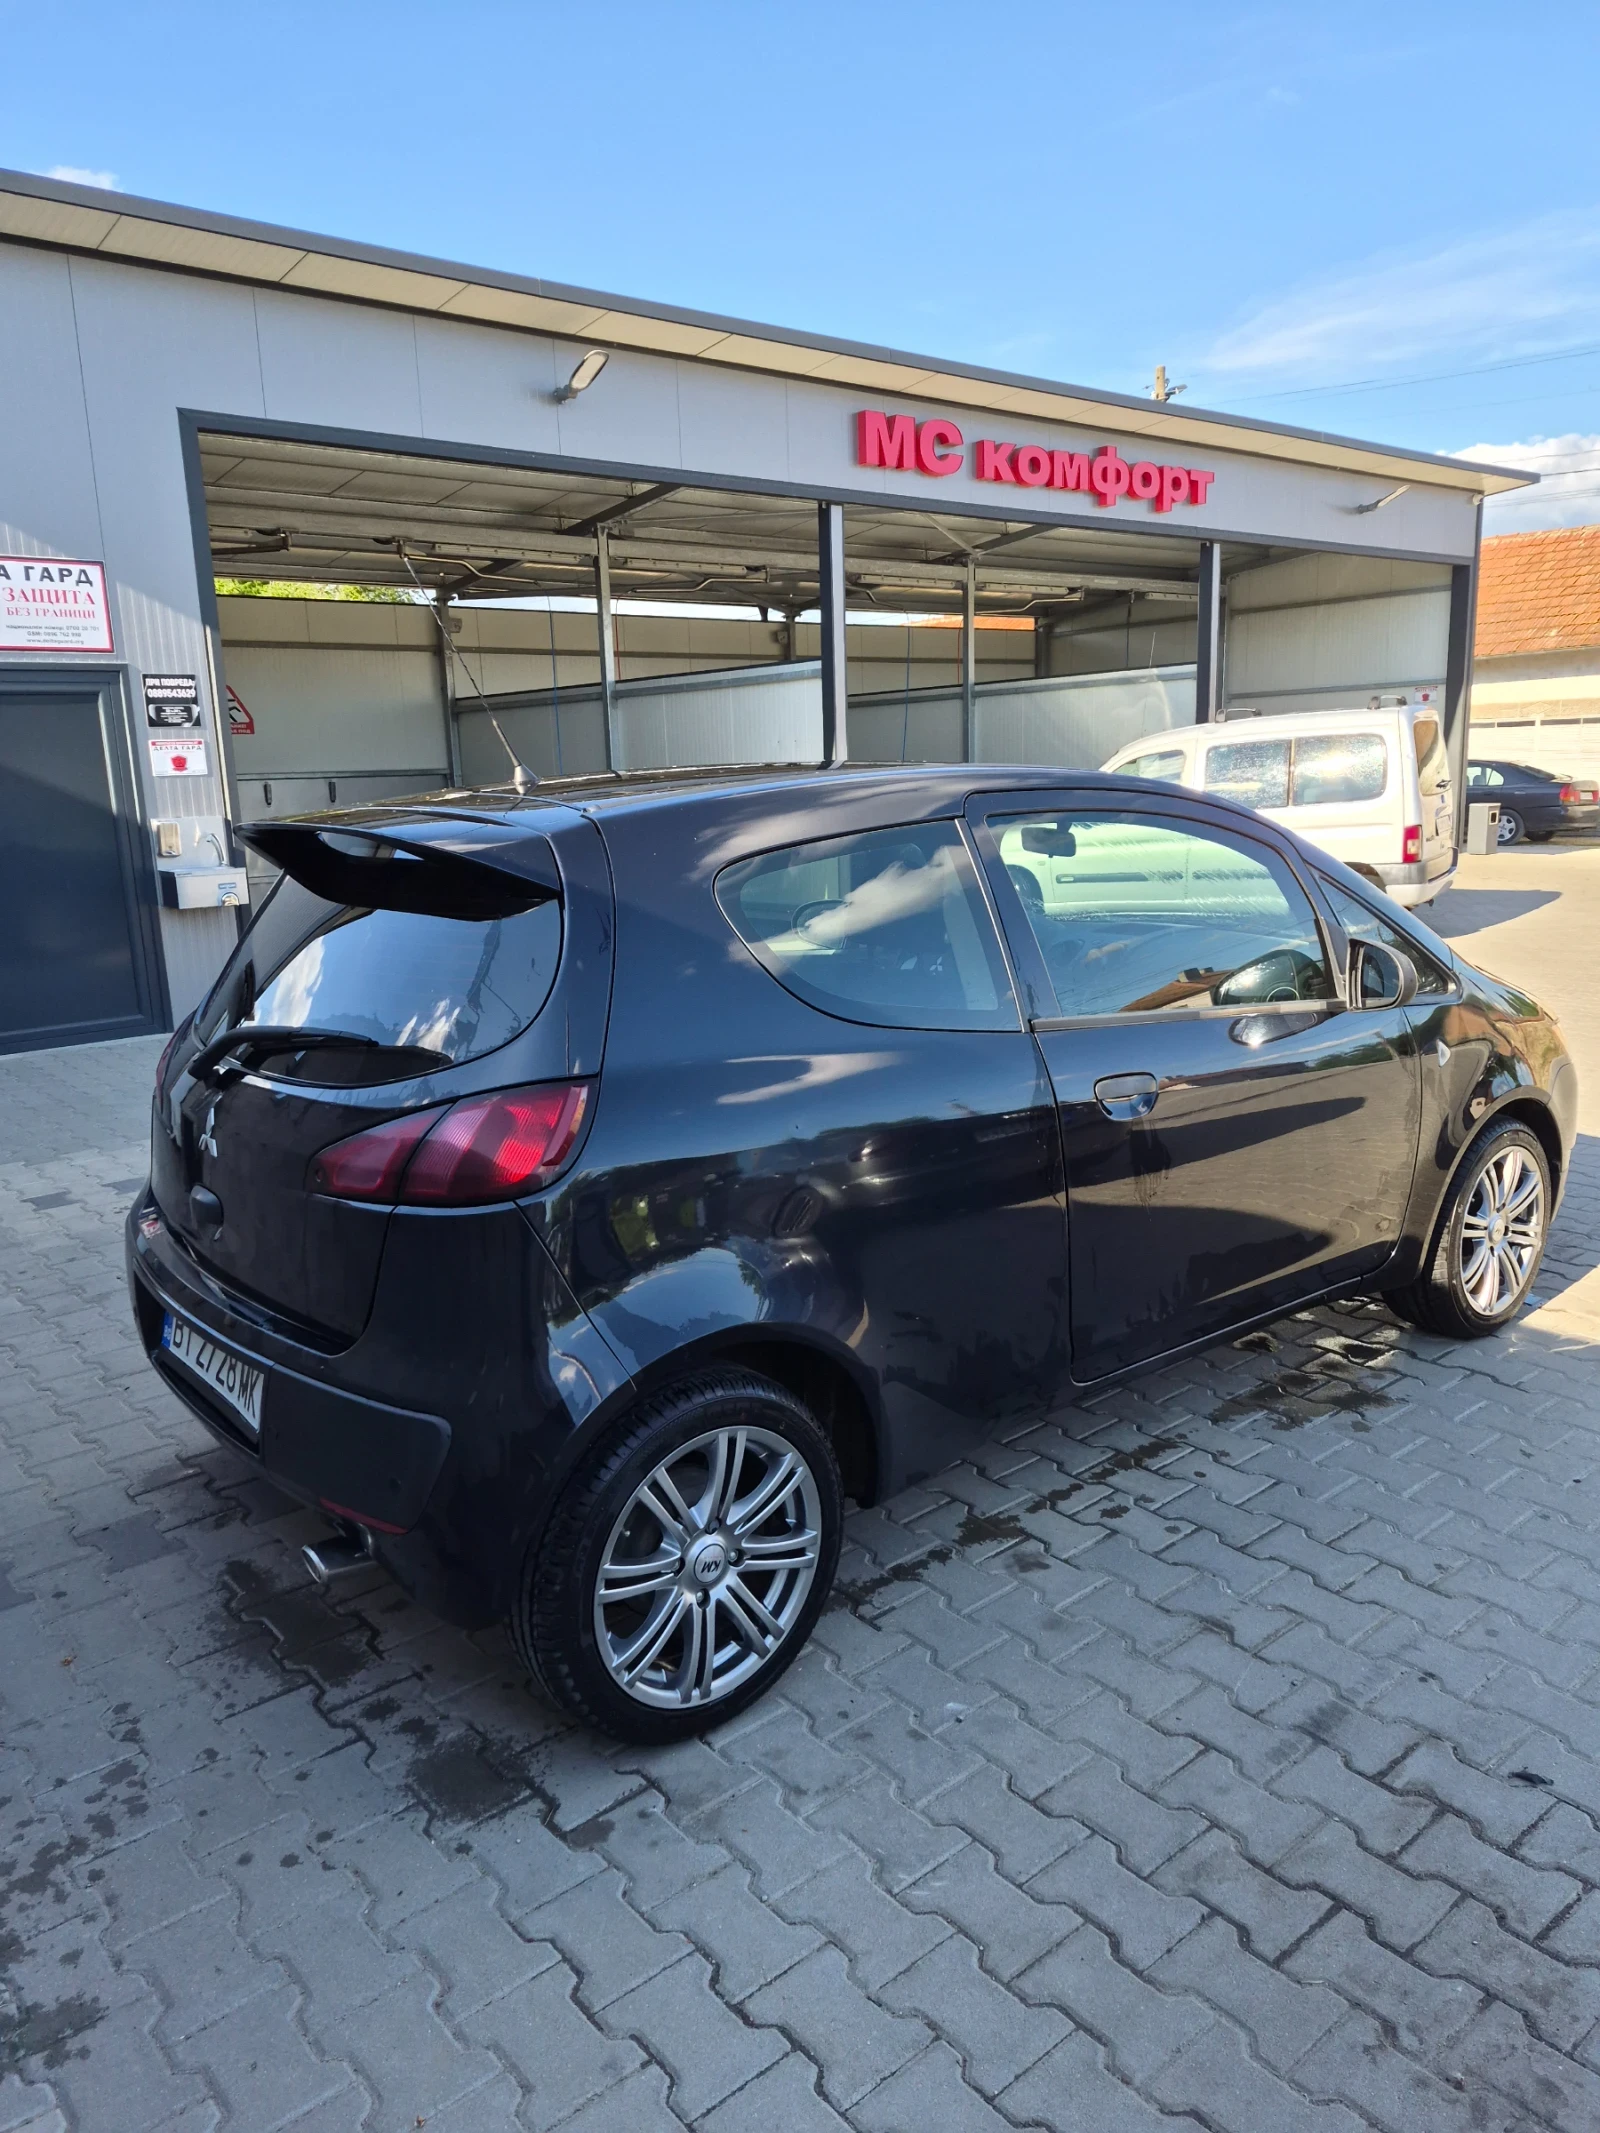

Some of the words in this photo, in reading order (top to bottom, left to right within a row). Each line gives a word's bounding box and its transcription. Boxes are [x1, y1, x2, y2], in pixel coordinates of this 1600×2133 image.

[857, 409, 964, 477] МС
[976, 440, 1214, 513] комфорт
[23, 565, 94, 587] ГАРД
[2, 586, 96, 605] ЗАЩИТА
[6, 606, 31, 617] БЕЗ
[35, 607, 96, 619] ГРАНИЦИ
[147, 688, 196, 698] 0889543629
